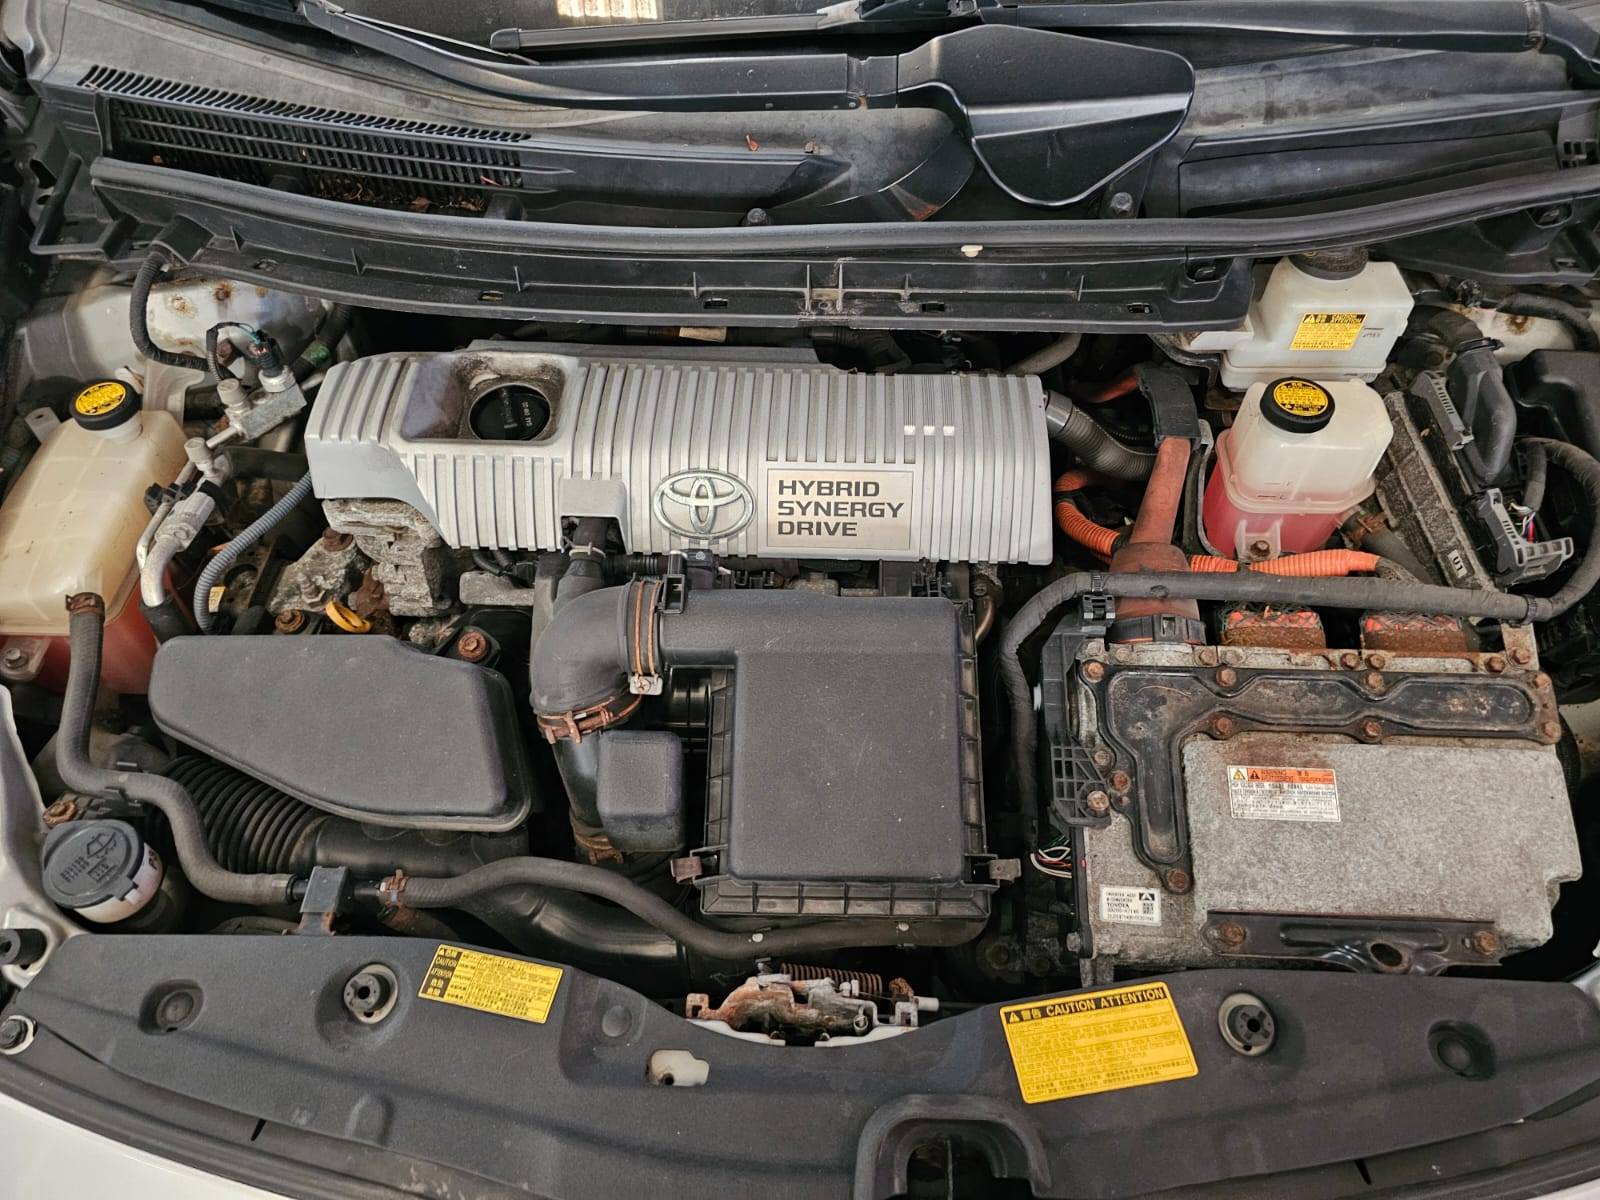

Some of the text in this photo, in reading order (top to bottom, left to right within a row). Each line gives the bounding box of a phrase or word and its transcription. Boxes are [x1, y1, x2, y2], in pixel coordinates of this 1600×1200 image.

[778, 480, 880, 496] HYBRID
[777, 500, 905, 518] SYNERGY
[777, 521, 858, 536] DRIVE
[1046, 1001, 1097, 1017] CAUTION
[1100, 987, 1166, 1009] ATTENTION
